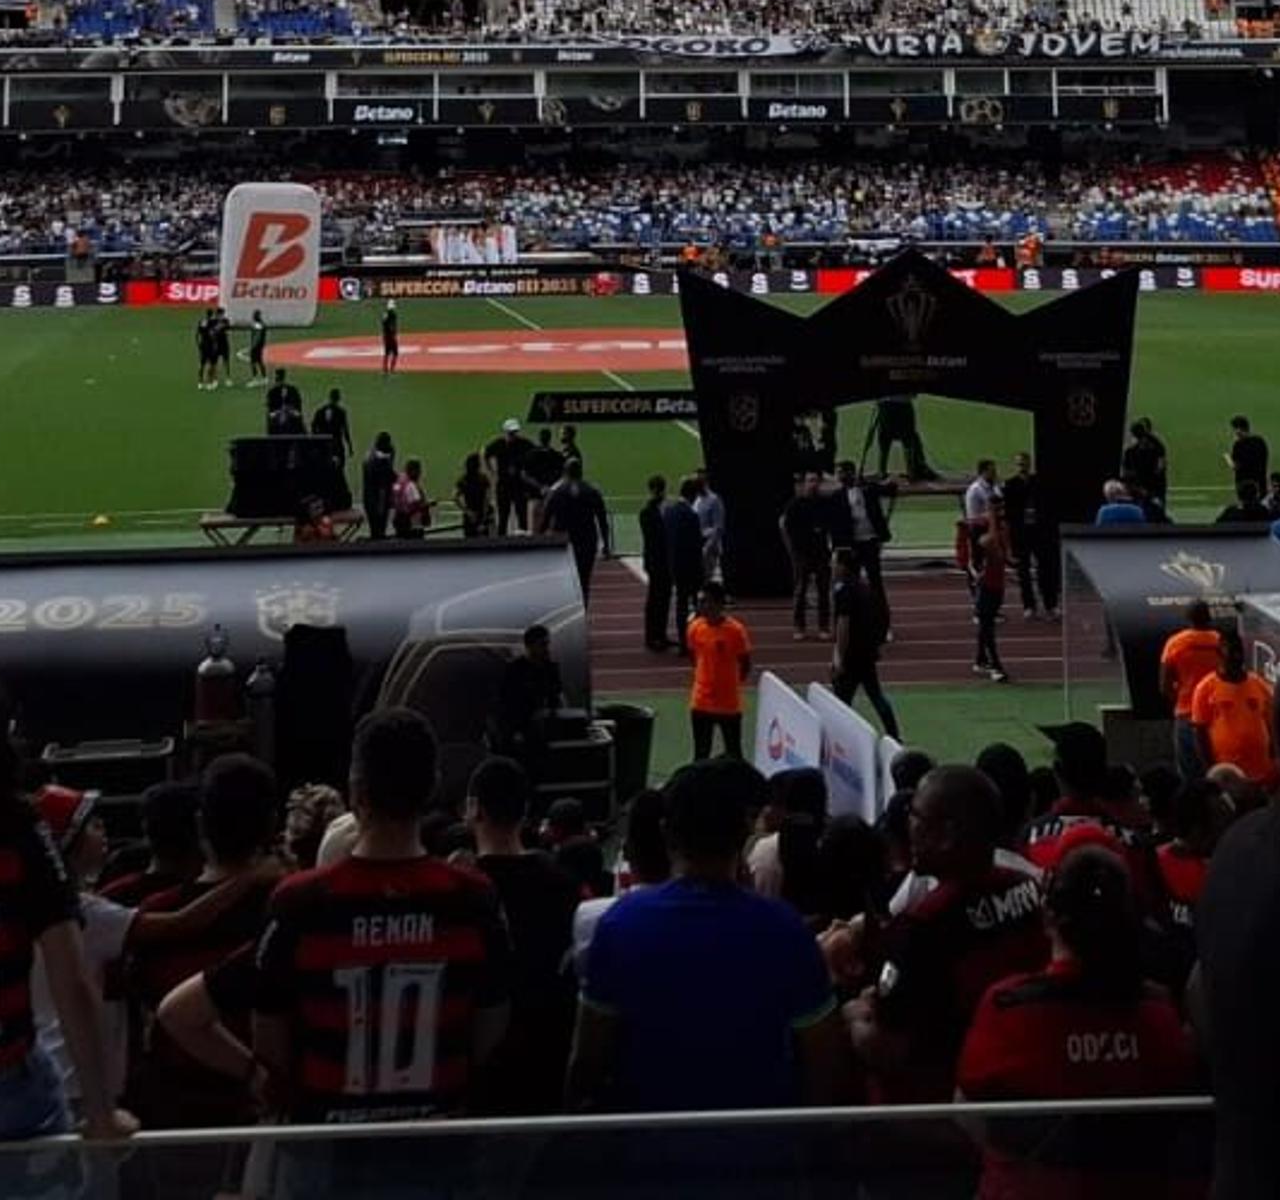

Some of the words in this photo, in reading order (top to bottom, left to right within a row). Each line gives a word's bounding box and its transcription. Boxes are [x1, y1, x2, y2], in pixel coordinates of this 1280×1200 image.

[1018, 31, 1160, 57] JOVEM
[354, 104, 413, 122] Betano
[769, 102, 827, 119] Betano
[231, 281, 308, 299] Betano
[463, 279, 516, 295] Betano
[562, 397, 652, 414] SUPERCOPA
[351, 911, 436, 949] RENAN
[332, 962, 449, 1096] 10
